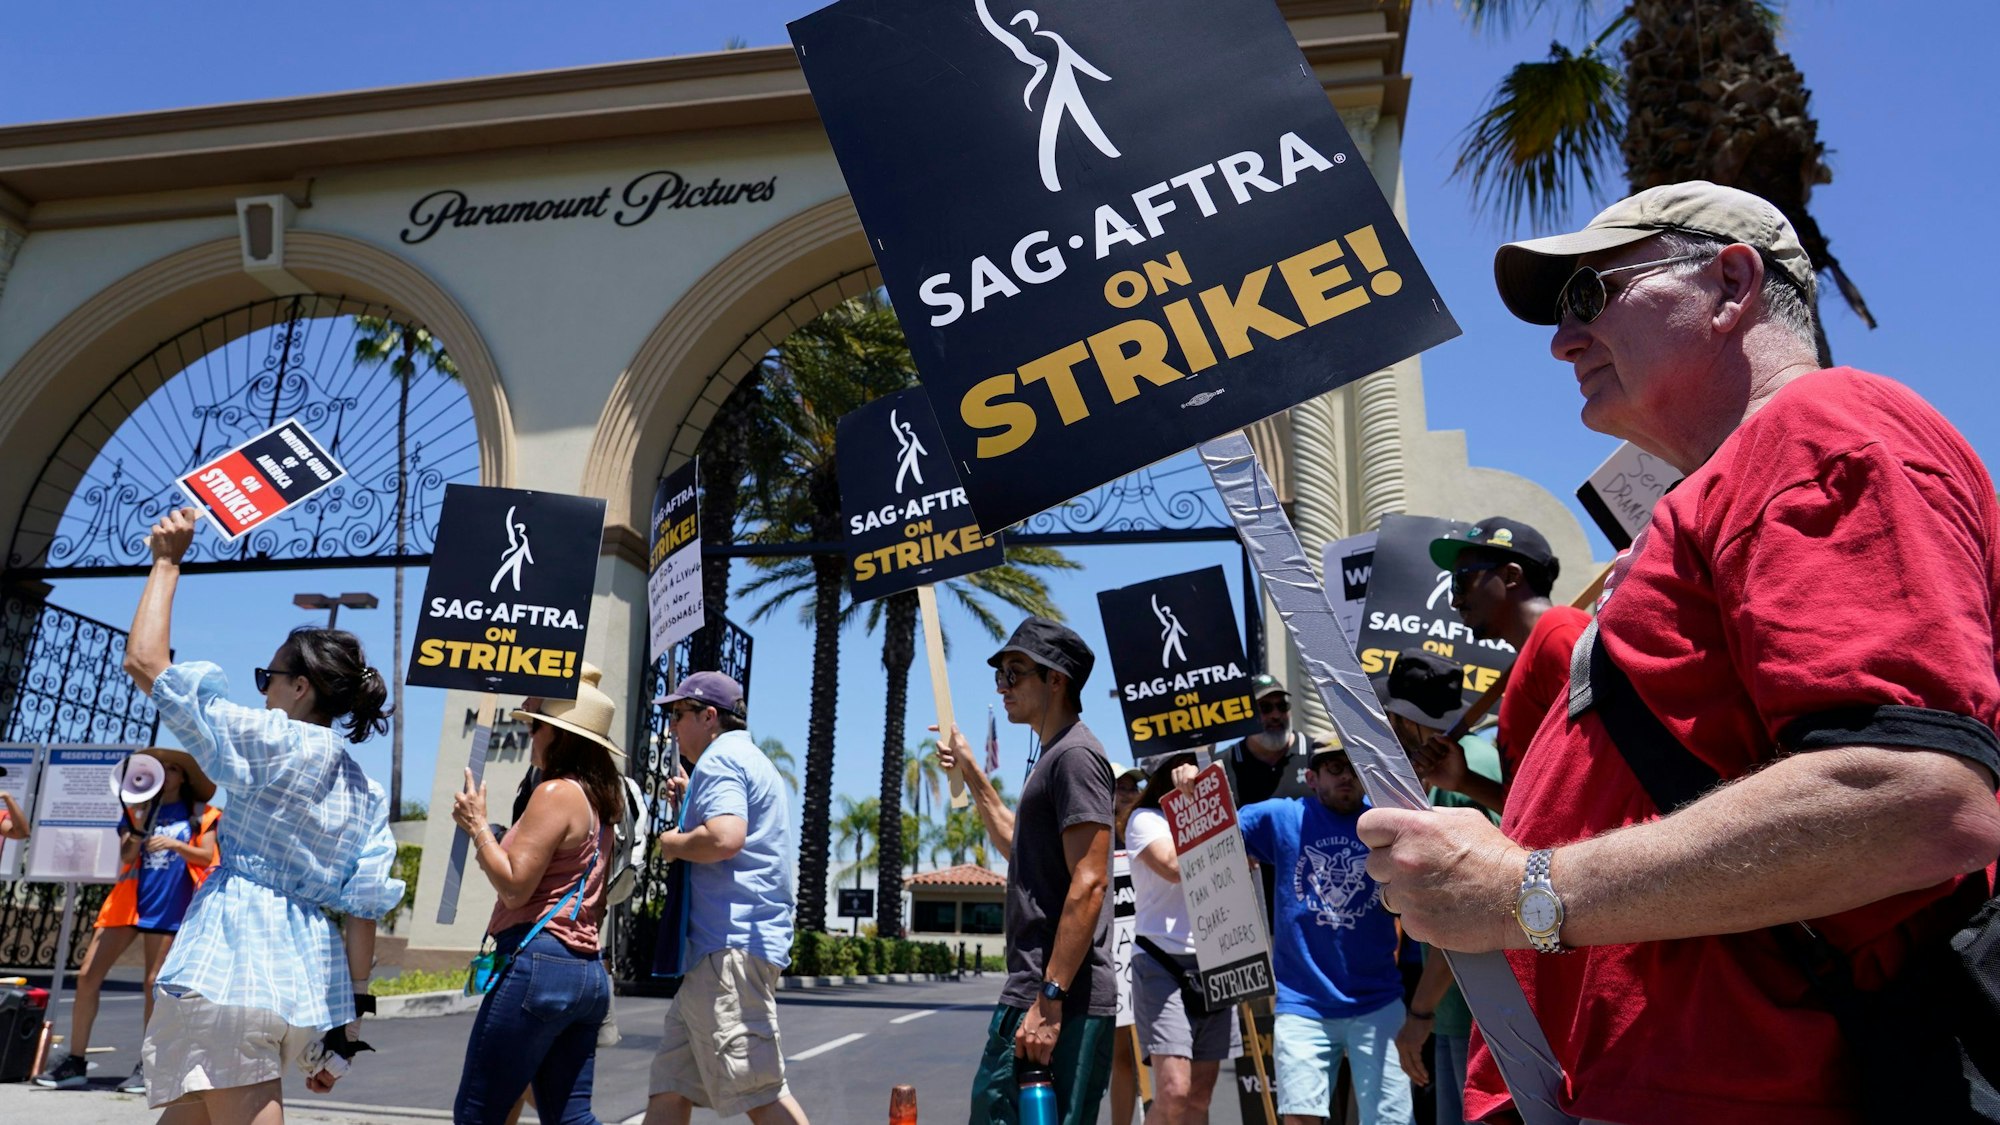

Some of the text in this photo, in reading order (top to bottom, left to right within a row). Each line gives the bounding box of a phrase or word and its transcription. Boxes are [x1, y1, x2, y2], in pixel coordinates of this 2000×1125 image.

[400, 170, 778, 245] Paramount Pictures
[1103, 250, 1193, 308] ON
[959, 224, 1403, 458] STRIKE!
[279, 428, 333, 482] WRITERS GUILD
[282, 456, 300, 469] OF
[240, 475, 263, 494] ON
[256, 454, 294, 490] AMERICA
[199, 467, 264, 526] STRIKE!
[660, 517, 671, 535] ON
[904, 518, 933, 539] ON
[649, 513, 697, 573] STRIKE!
[675, 561, 702, 584] LIVING
[672, 591, 691, 606] NOT
[485, 626, 517, 644] ON
[1422, 640, 1454, 658] ON
[417, 638, 577, 679] STRIKE!
[1174, 691, 1200, 708] ON
[1130, 694, 1254, 742] STRIKE!
[61, 751, 103, 761] RESERVED
[1175, 793, 1222, 830] GUILD OF
[1177, 805, 1229, 848] AMERICA
[1315, 836, 1350, 849] GUILD
[1210, 867, 1236, 892] YOUR
[1218, 923, 1256, 956] HOLDERS
[1208, 960, 1270, 1003] STRIKE
